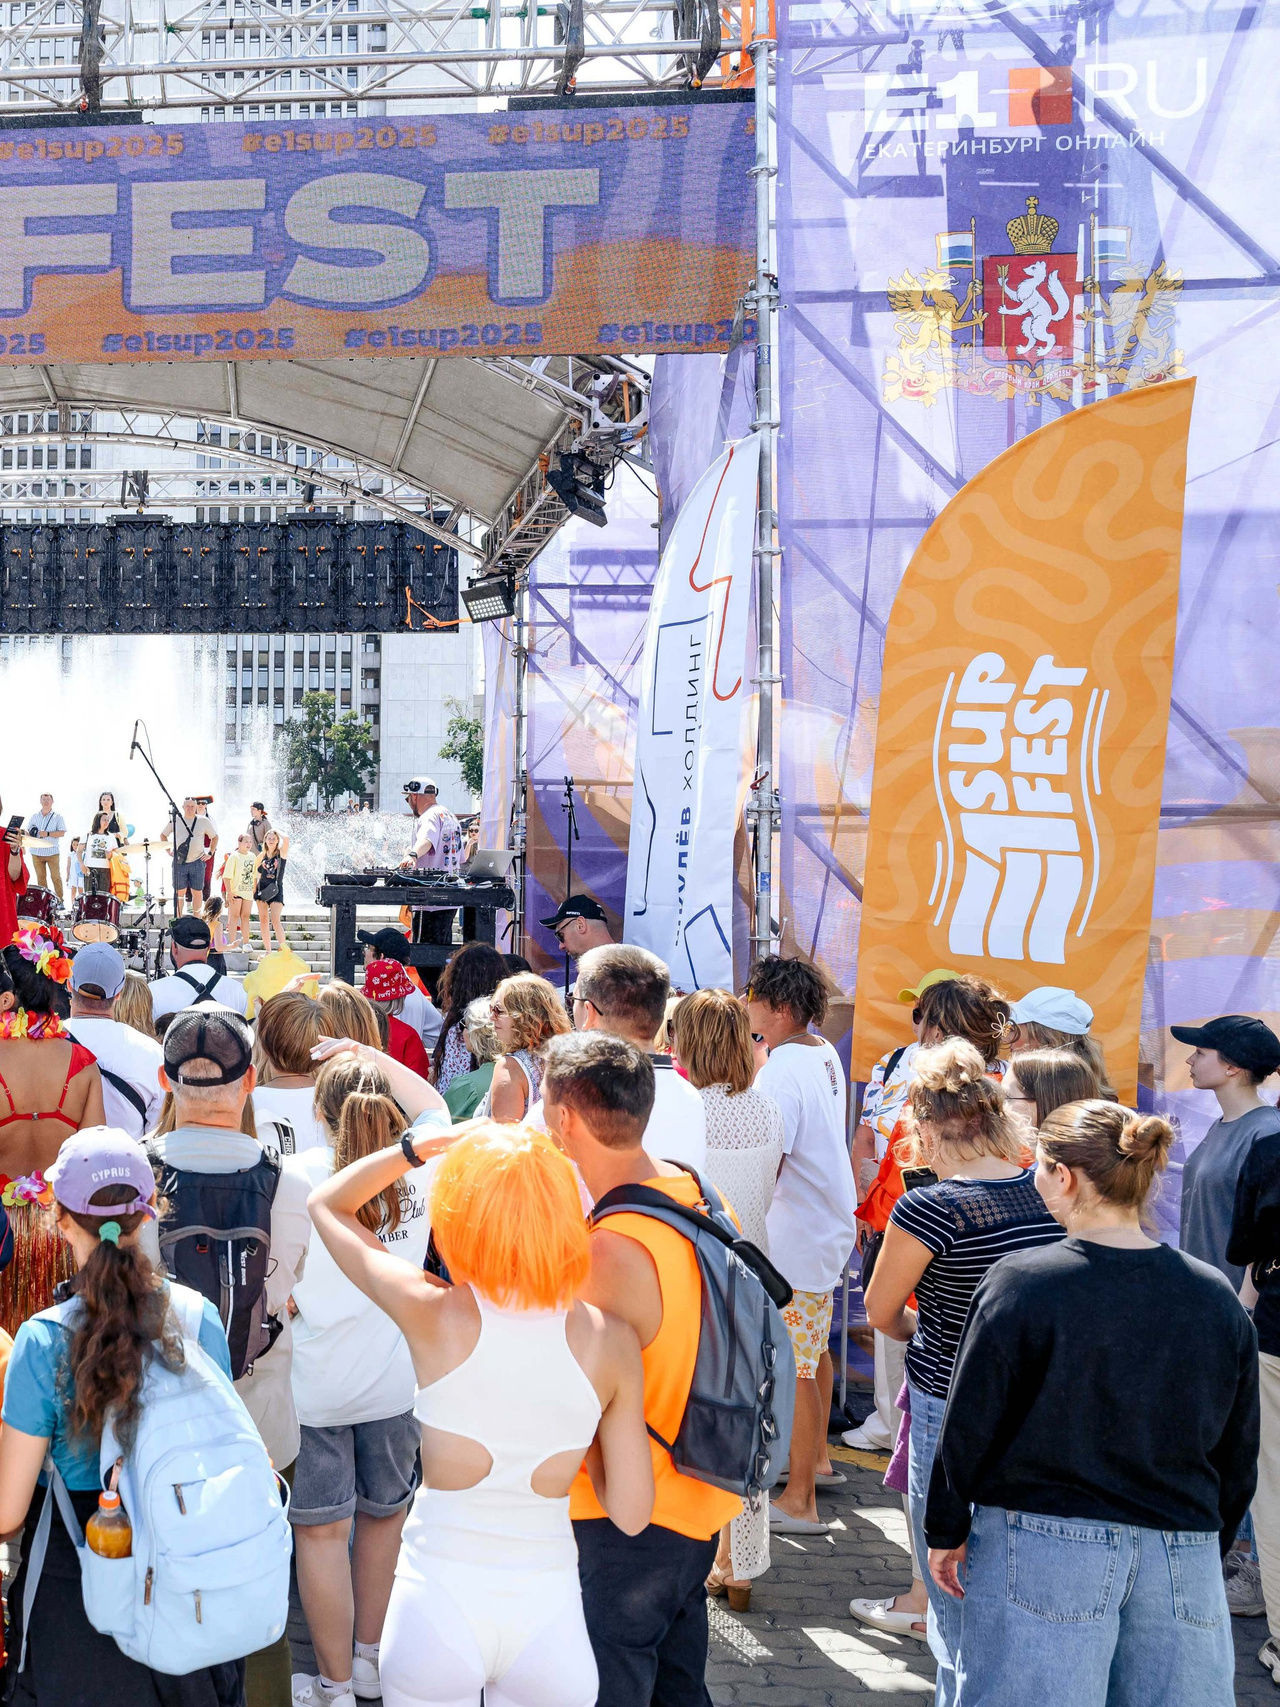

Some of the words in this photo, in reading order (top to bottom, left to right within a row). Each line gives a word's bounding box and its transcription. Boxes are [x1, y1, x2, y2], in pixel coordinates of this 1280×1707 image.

[1084, 58, 1207, 122] RU
[242, 124, 437, 155] #e1sup2025
[487, 115, 690, 145] #e1sup2025
[865, 137, 1048, 159] ЕКАТЕРИНБУРГ
[1055, 128, 1165, 152] ОНЛАЙН
[101, 327, 295, 356] #e1sup2025
[344, 322, 543, 350] #e1sup2025
[683, 634, 701, 791] ХОЛДИНГ
[948, 652, 1016, 811] SUP
[1010, 654, 1088, 813] FEST
[91, 1167, 131, 1182] CYPRUS
[378, 1229, 408, 1244] MBER
